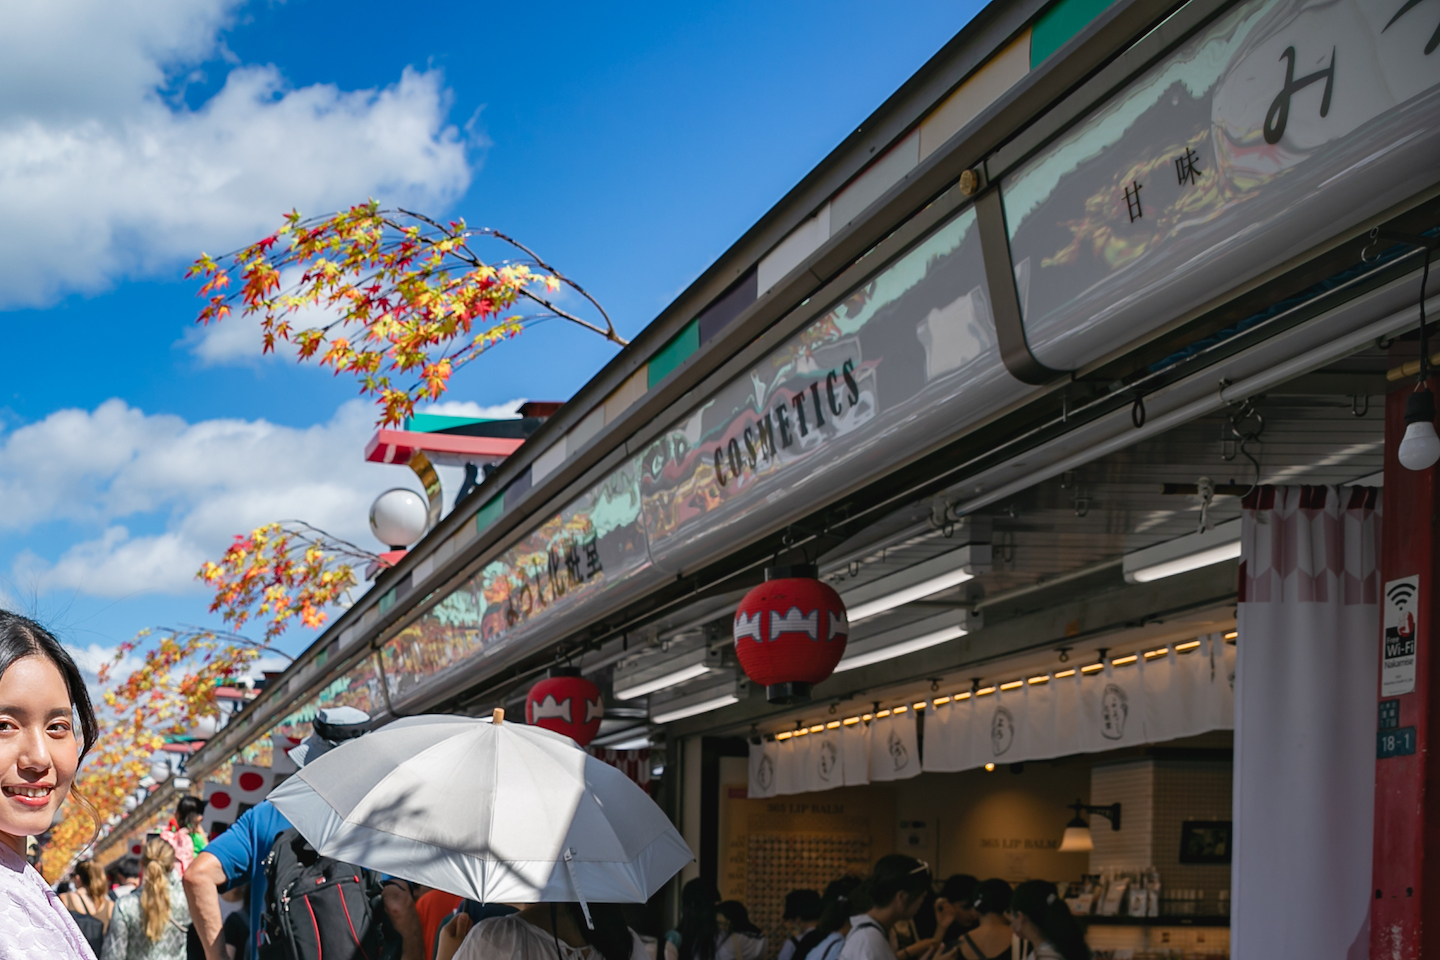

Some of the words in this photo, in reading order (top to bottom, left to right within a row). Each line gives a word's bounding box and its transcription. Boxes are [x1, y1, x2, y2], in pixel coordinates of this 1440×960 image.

[1122, 146, 1202, 224] 甘味
[713, 357, 860, 487] COSMETICS
[1386, 636, 1400, 645] Free
[1387, 640, 1414, 657] Wi-Fi
[1384, 657, 1414, 670] Nakamise
[1382, 733, 1410, 752] 18-1
